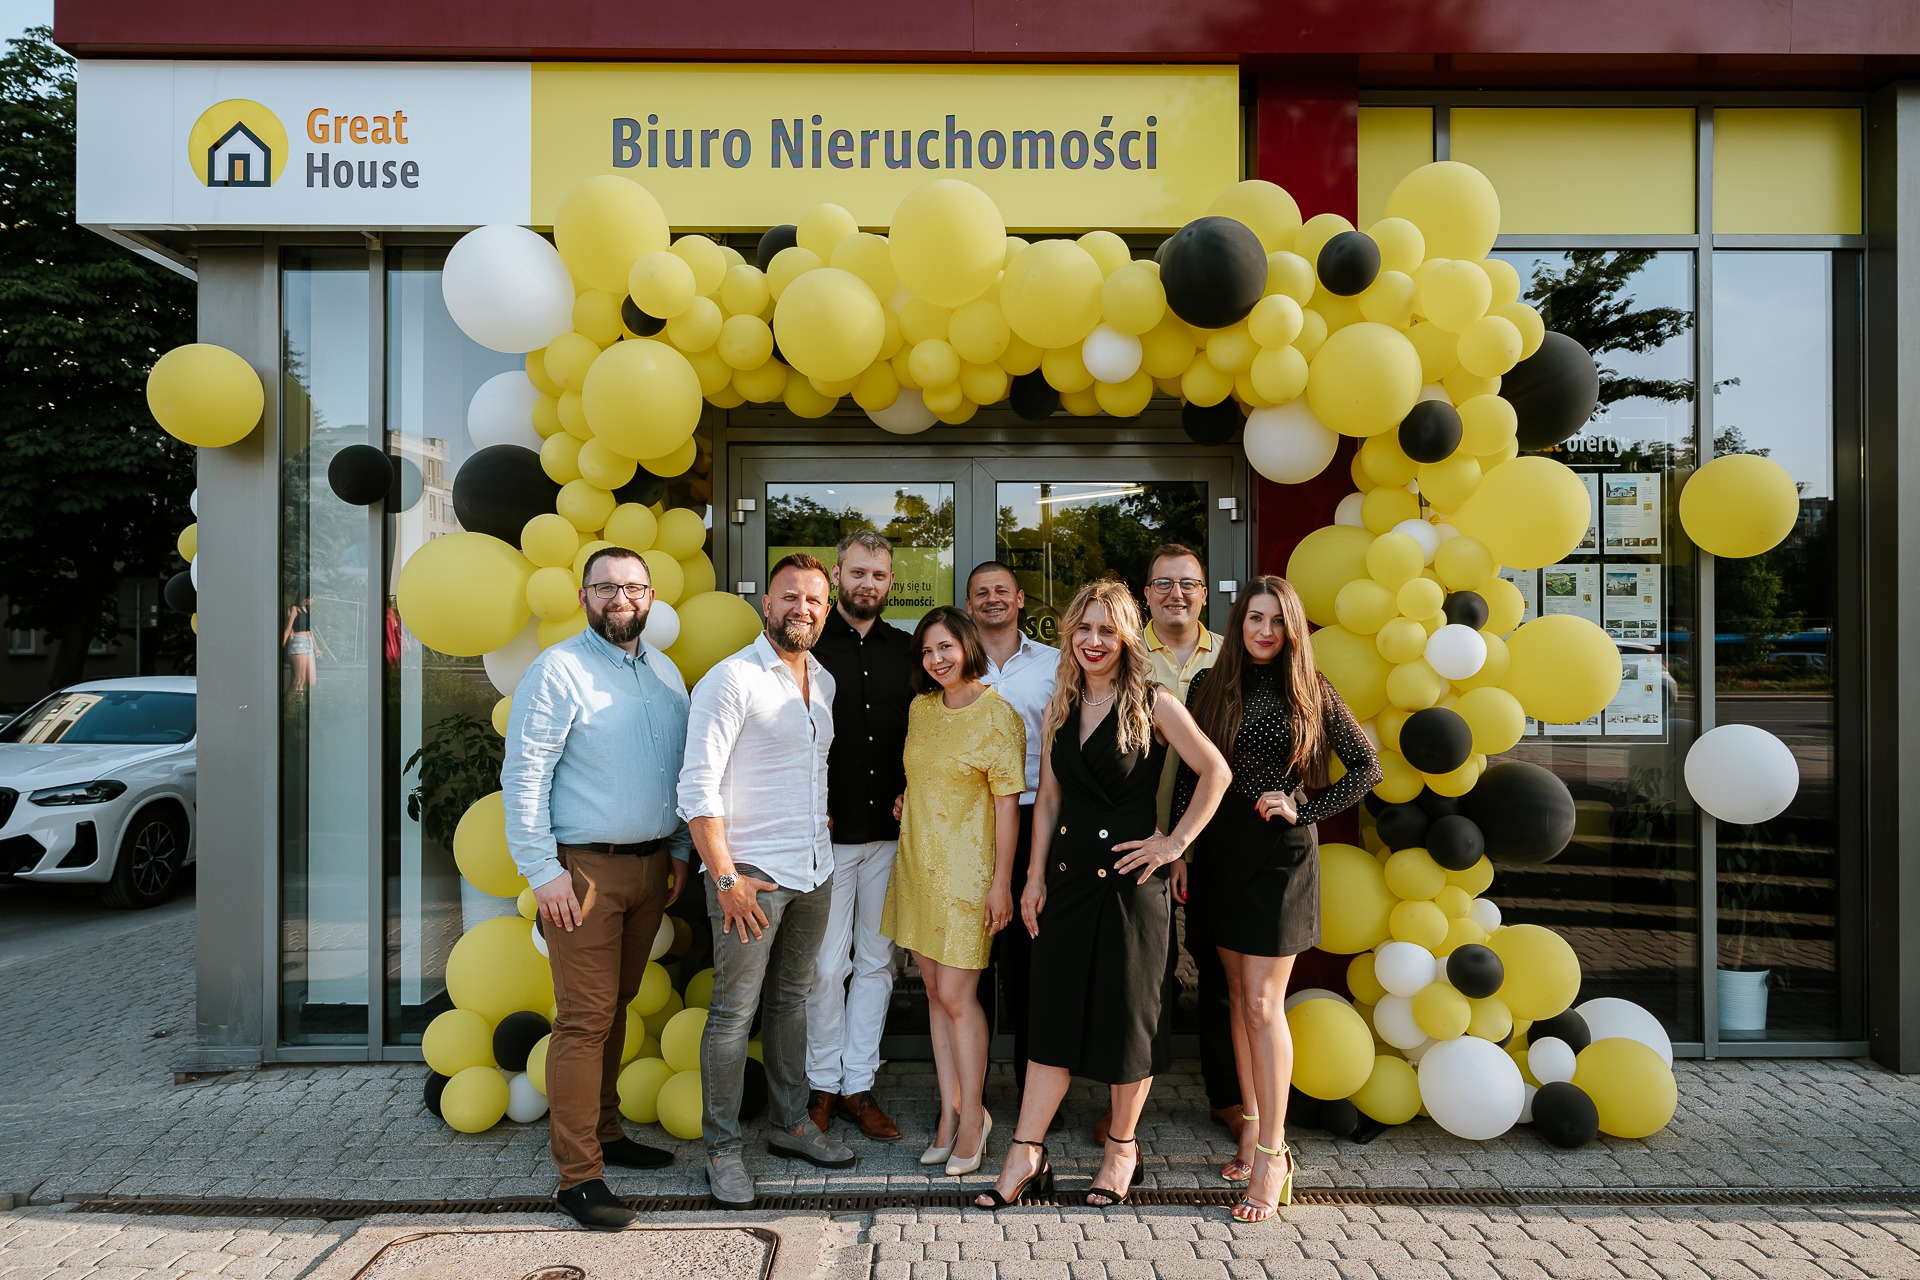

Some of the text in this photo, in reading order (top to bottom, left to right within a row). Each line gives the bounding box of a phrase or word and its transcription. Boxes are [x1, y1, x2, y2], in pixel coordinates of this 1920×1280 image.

[307, 107, 408, 144] Great
[612, 113, 1158, 170] Biuro Nieruchomości
[306, 152, 420, 188] House
[884, 595, 935, 607] uchomości:
[907, 580, 920, 594] się
[922, 581, 932, 592] tu
